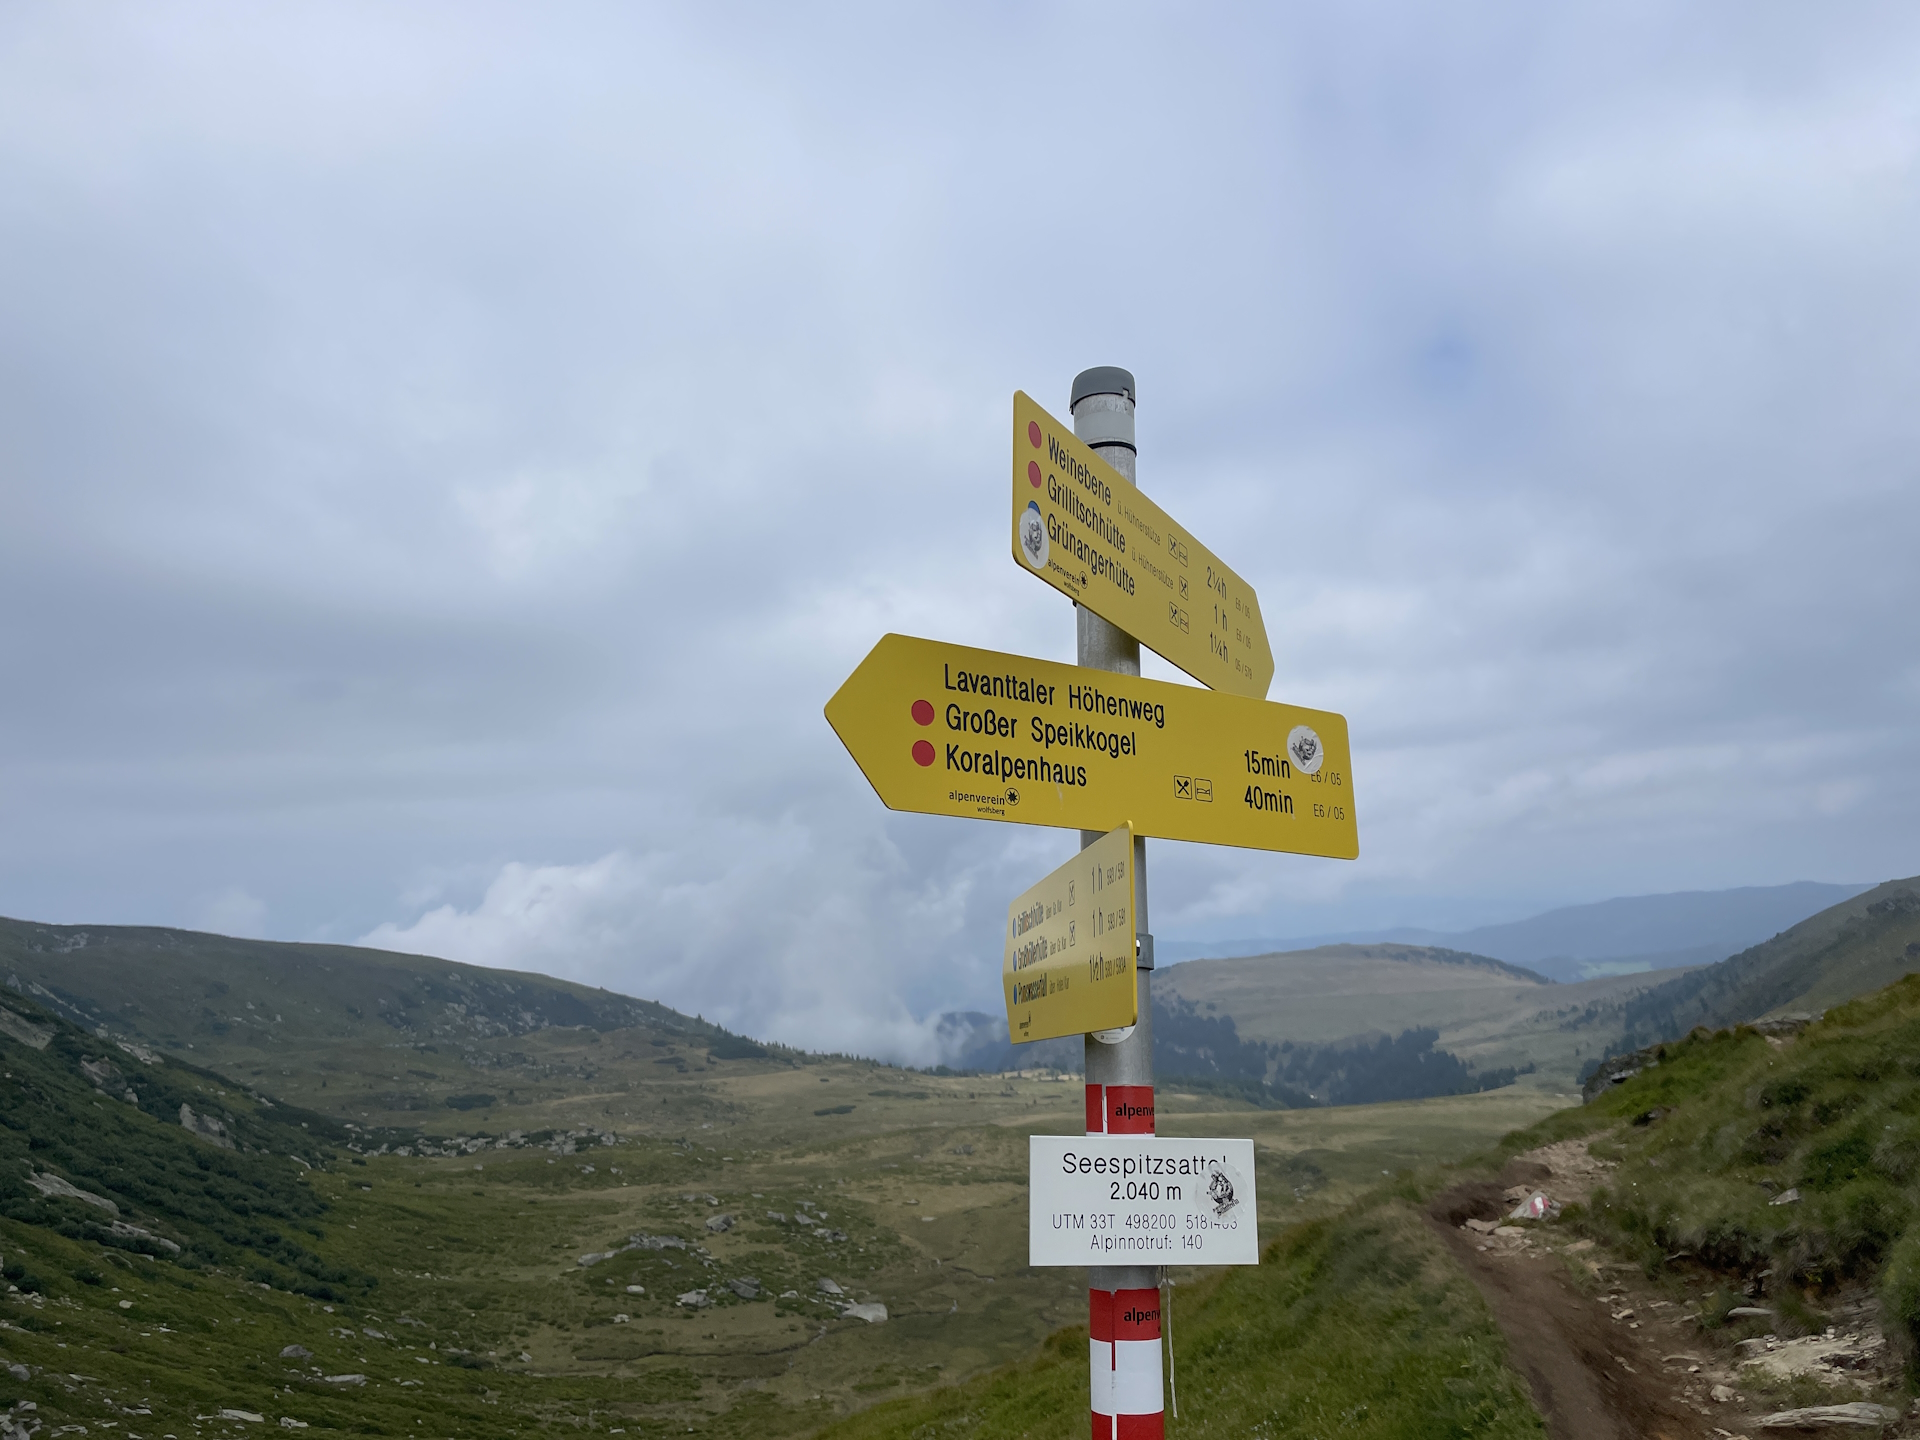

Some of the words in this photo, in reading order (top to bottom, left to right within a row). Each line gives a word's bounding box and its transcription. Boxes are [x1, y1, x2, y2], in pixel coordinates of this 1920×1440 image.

[1048, 433, 1111, 506] Weinebene
[1047, 473, 1126, 553] Grillitschhütte
[1047, 512, 1135, 596] Grünangerhütte
[1048, 558, 1080, 587] alpenverein
[944, 663, 1055, 706] Lavanttaler
[1068, 684, 1165, 729] Höhenweg
[945, 703, 1017, 738] Großer
[1031, 716, 1136, 759] Speikkogel
[946, 743, 1087, 787] Koralpenhaus
[1244, 749, 1291, 780] 15min
[1330, 772, 1342, 786] 05
[949, 790, 1005, 806] alpenverein
[977, 806, 1005, 816] wolfsberg
[1244, 785, 1294, 815] 40min
[1313, 803, 1325, 818] E6
[1333, 806, 1345, 821] 05
[1110, 1181, 1160, 1200] 2.040
[1166, 1185, 1182, 1200] m
[1052, 1214, 1084, 1229] UTM
[1090, 1214, 1116, 1229] 33T
[1125, 1214, 1177, 1230] 498200
[1090, 1234, 1173, 1253] Alpinnotruf:
[1181, 1234, 1203, 1250] 140
